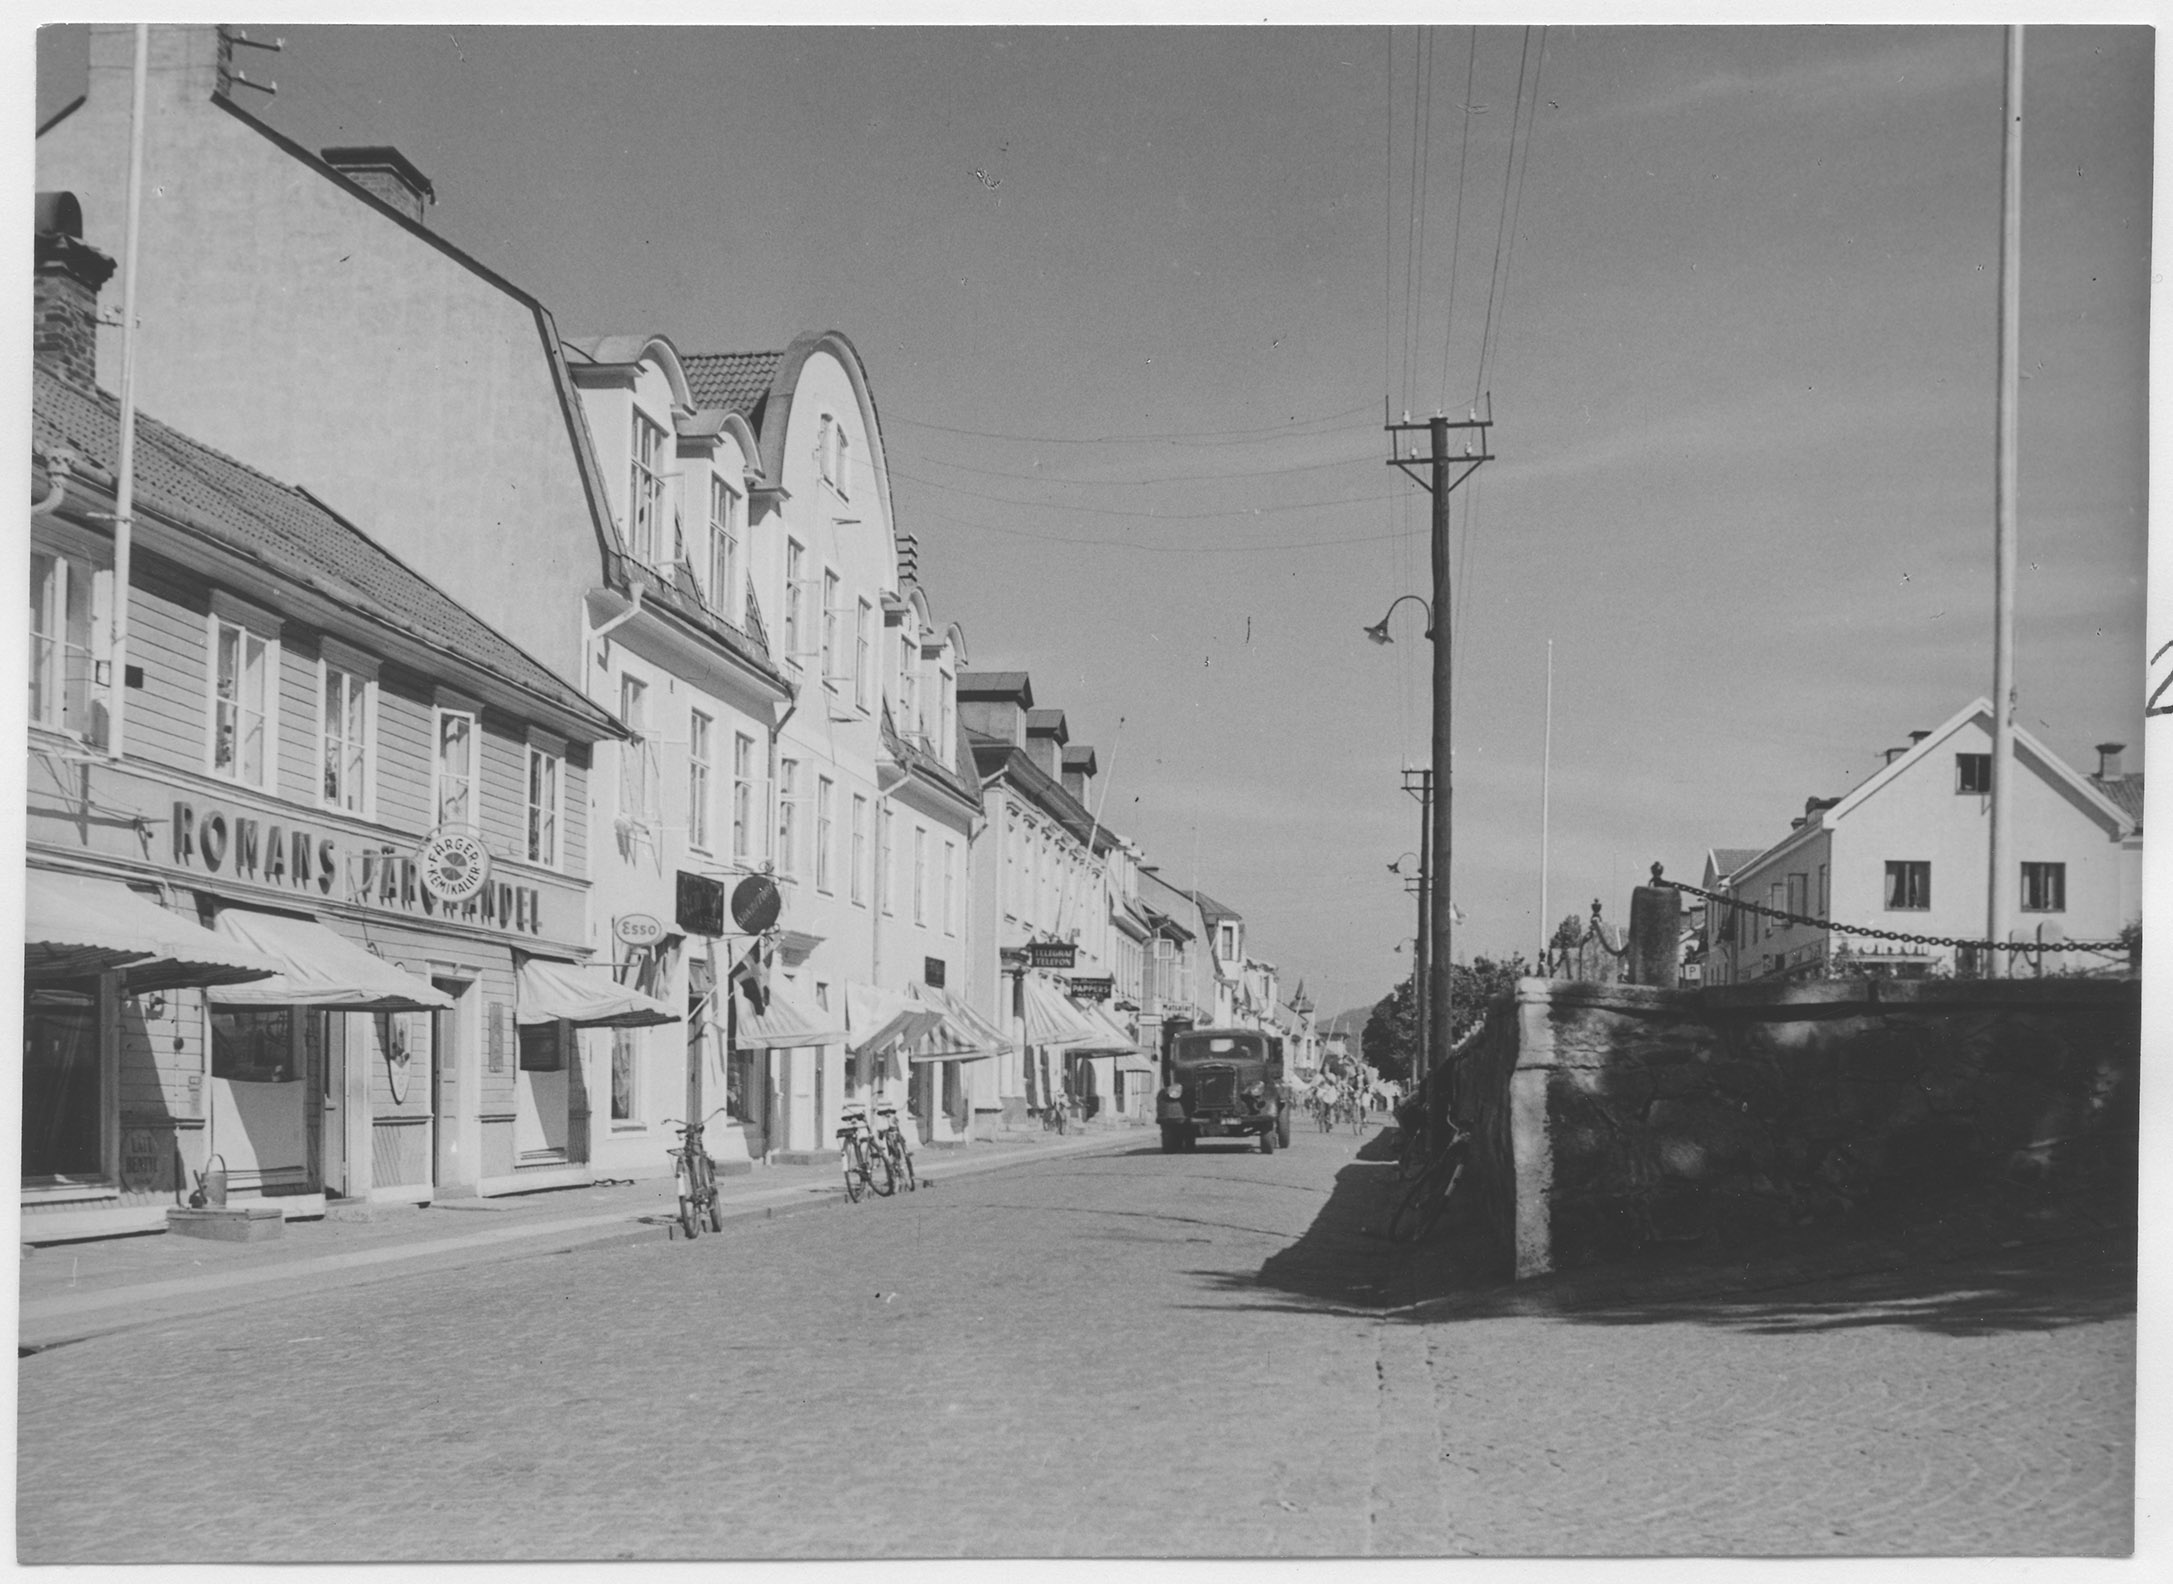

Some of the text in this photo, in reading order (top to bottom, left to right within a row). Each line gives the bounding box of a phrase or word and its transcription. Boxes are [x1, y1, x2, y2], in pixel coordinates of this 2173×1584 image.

[173, 801, 335, 895] ROMANS
[428, 838, 479, 863] FÄRGER
[427, 866, 481, 895] KEMIKALIER
[1036, 958, 1072, 966] TELEFON
[1689, 966, 1697, 977] P
